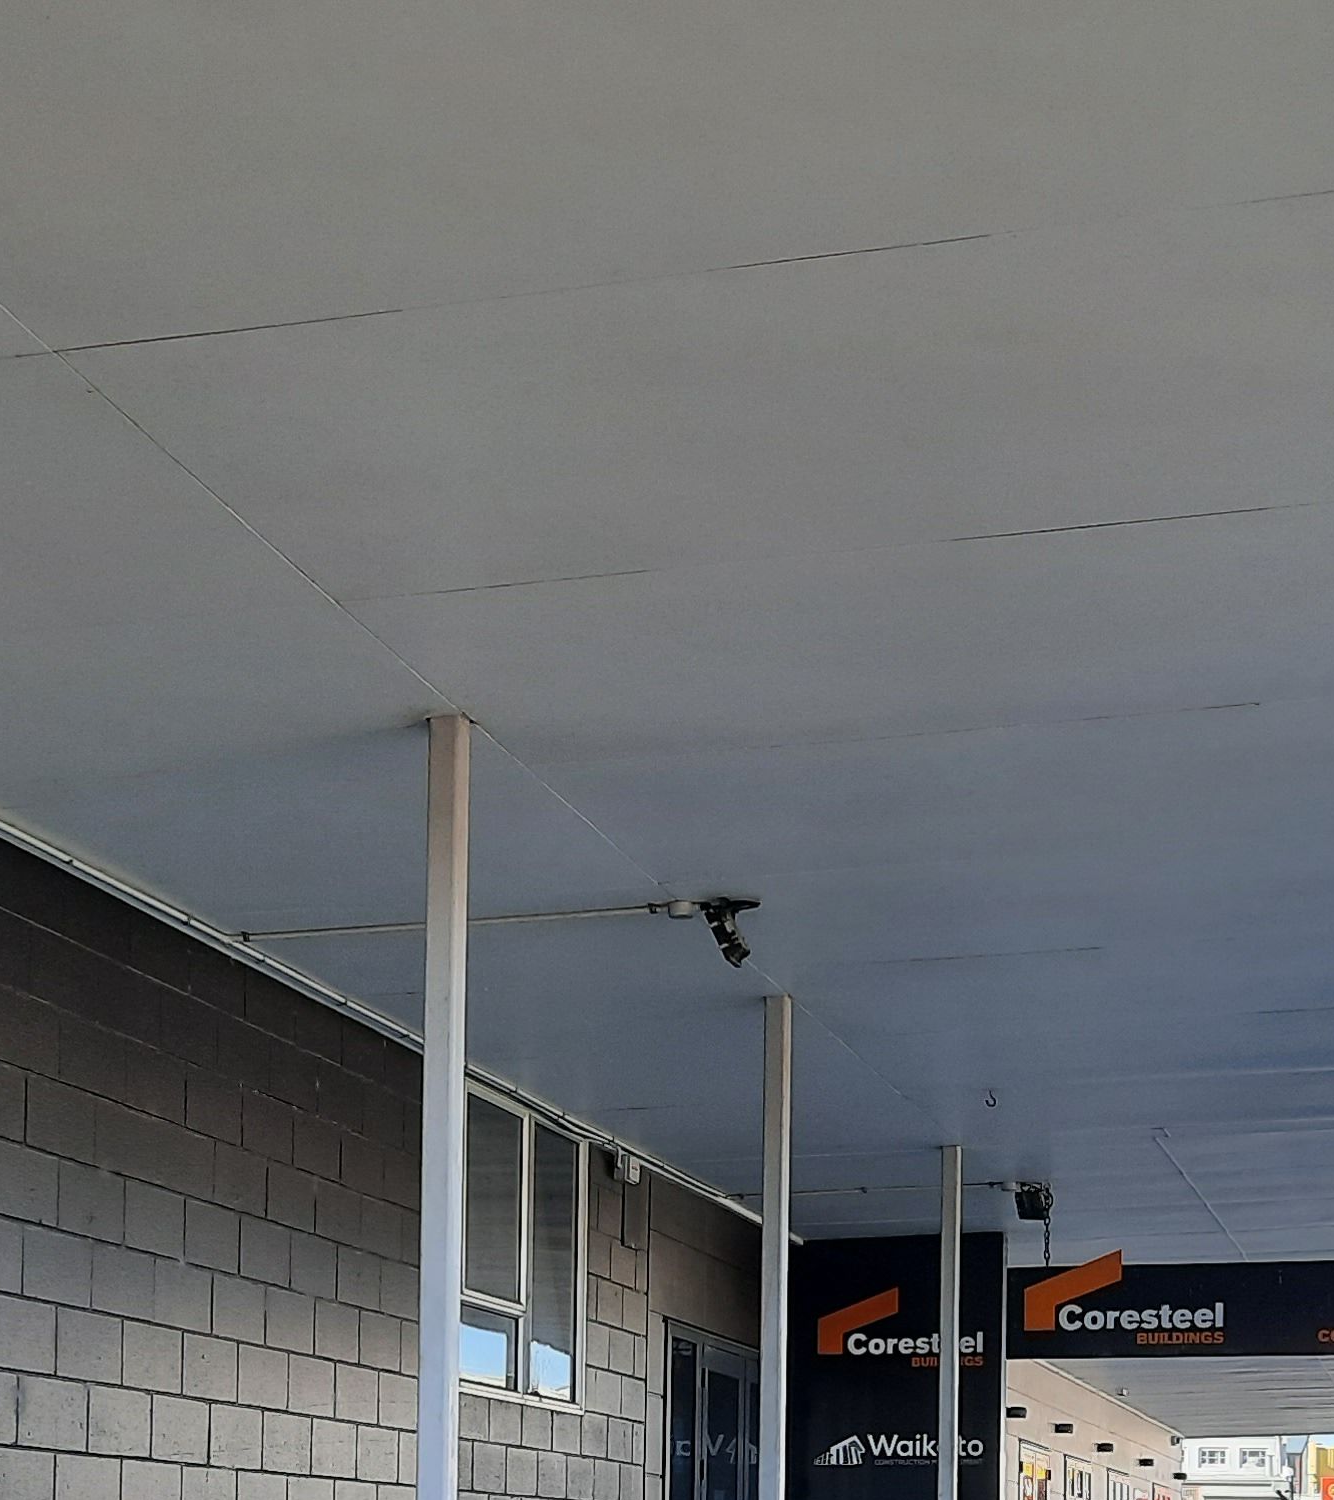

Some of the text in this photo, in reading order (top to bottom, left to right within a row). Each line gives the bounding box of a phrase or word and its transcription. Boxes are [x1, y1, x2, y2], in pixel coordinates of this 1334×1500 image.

[1058, 1302, 1224, 1331] Coresteel
[847, 1331, 984, 1355] Corestel
[1136, 1331, 1225, 1345] BUILDINGS
[867, 1433, 984, 1457] Waikto
